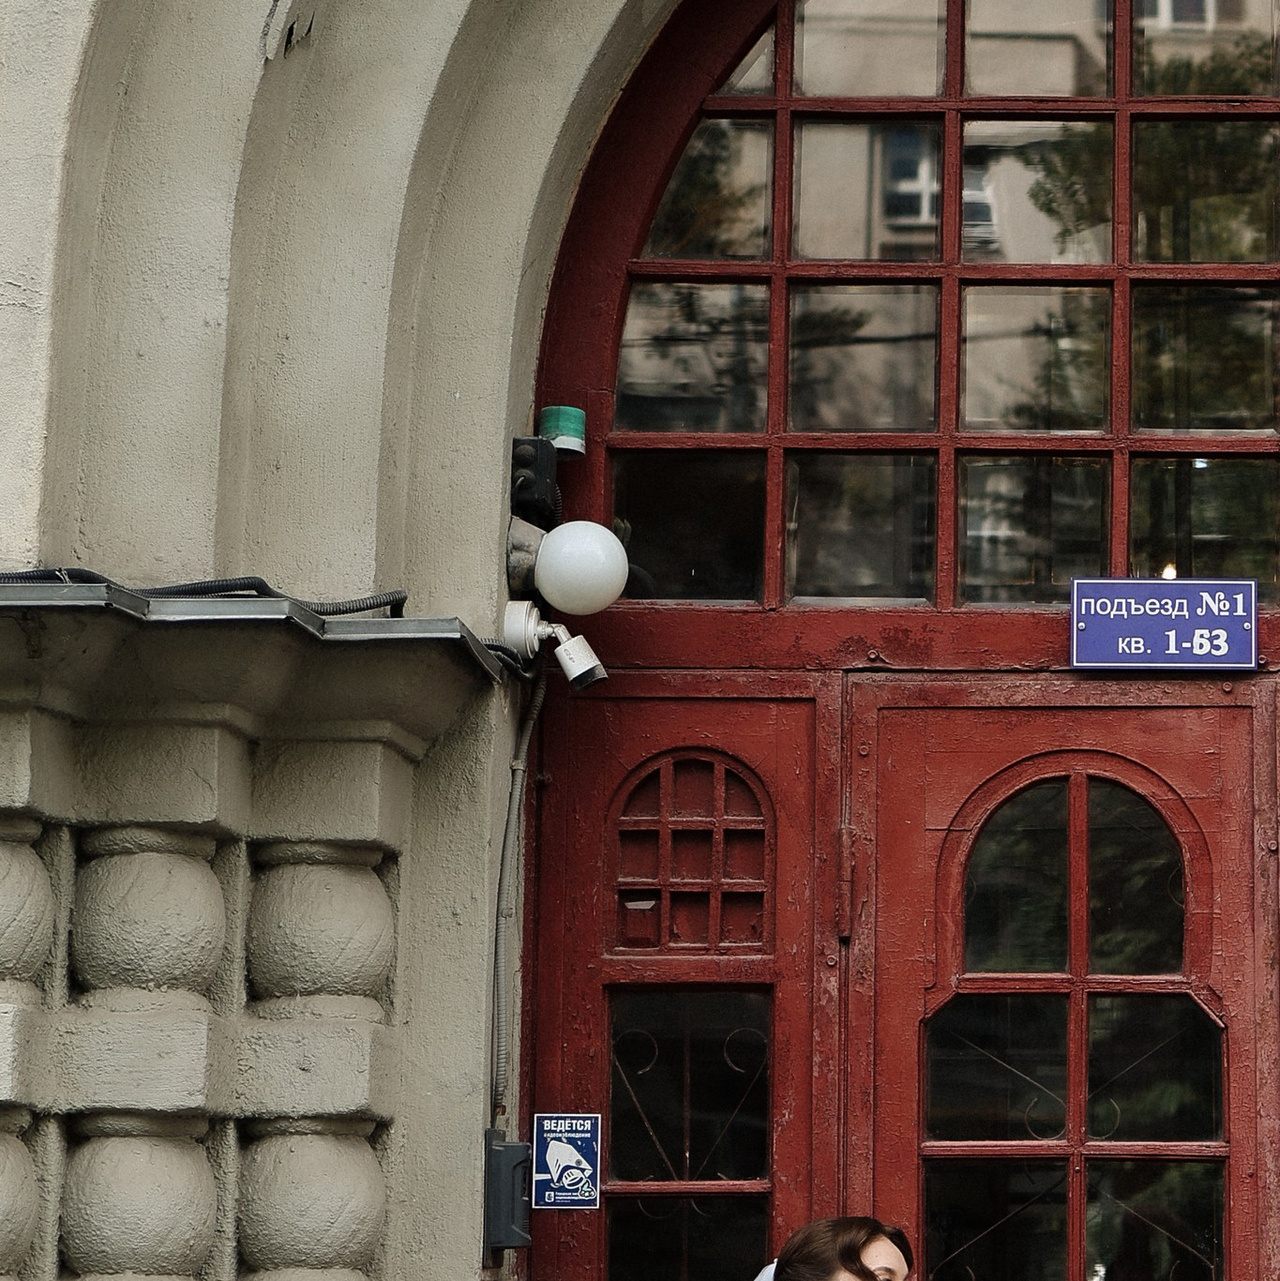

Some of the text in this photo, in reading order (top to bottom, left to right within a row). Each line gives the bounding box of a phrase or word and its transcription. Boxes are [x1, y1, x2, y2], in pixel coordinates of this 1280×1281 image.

[1081, 591, 1247, 619] подъезд №1
[1118, 637, 1152, 654] кв.
